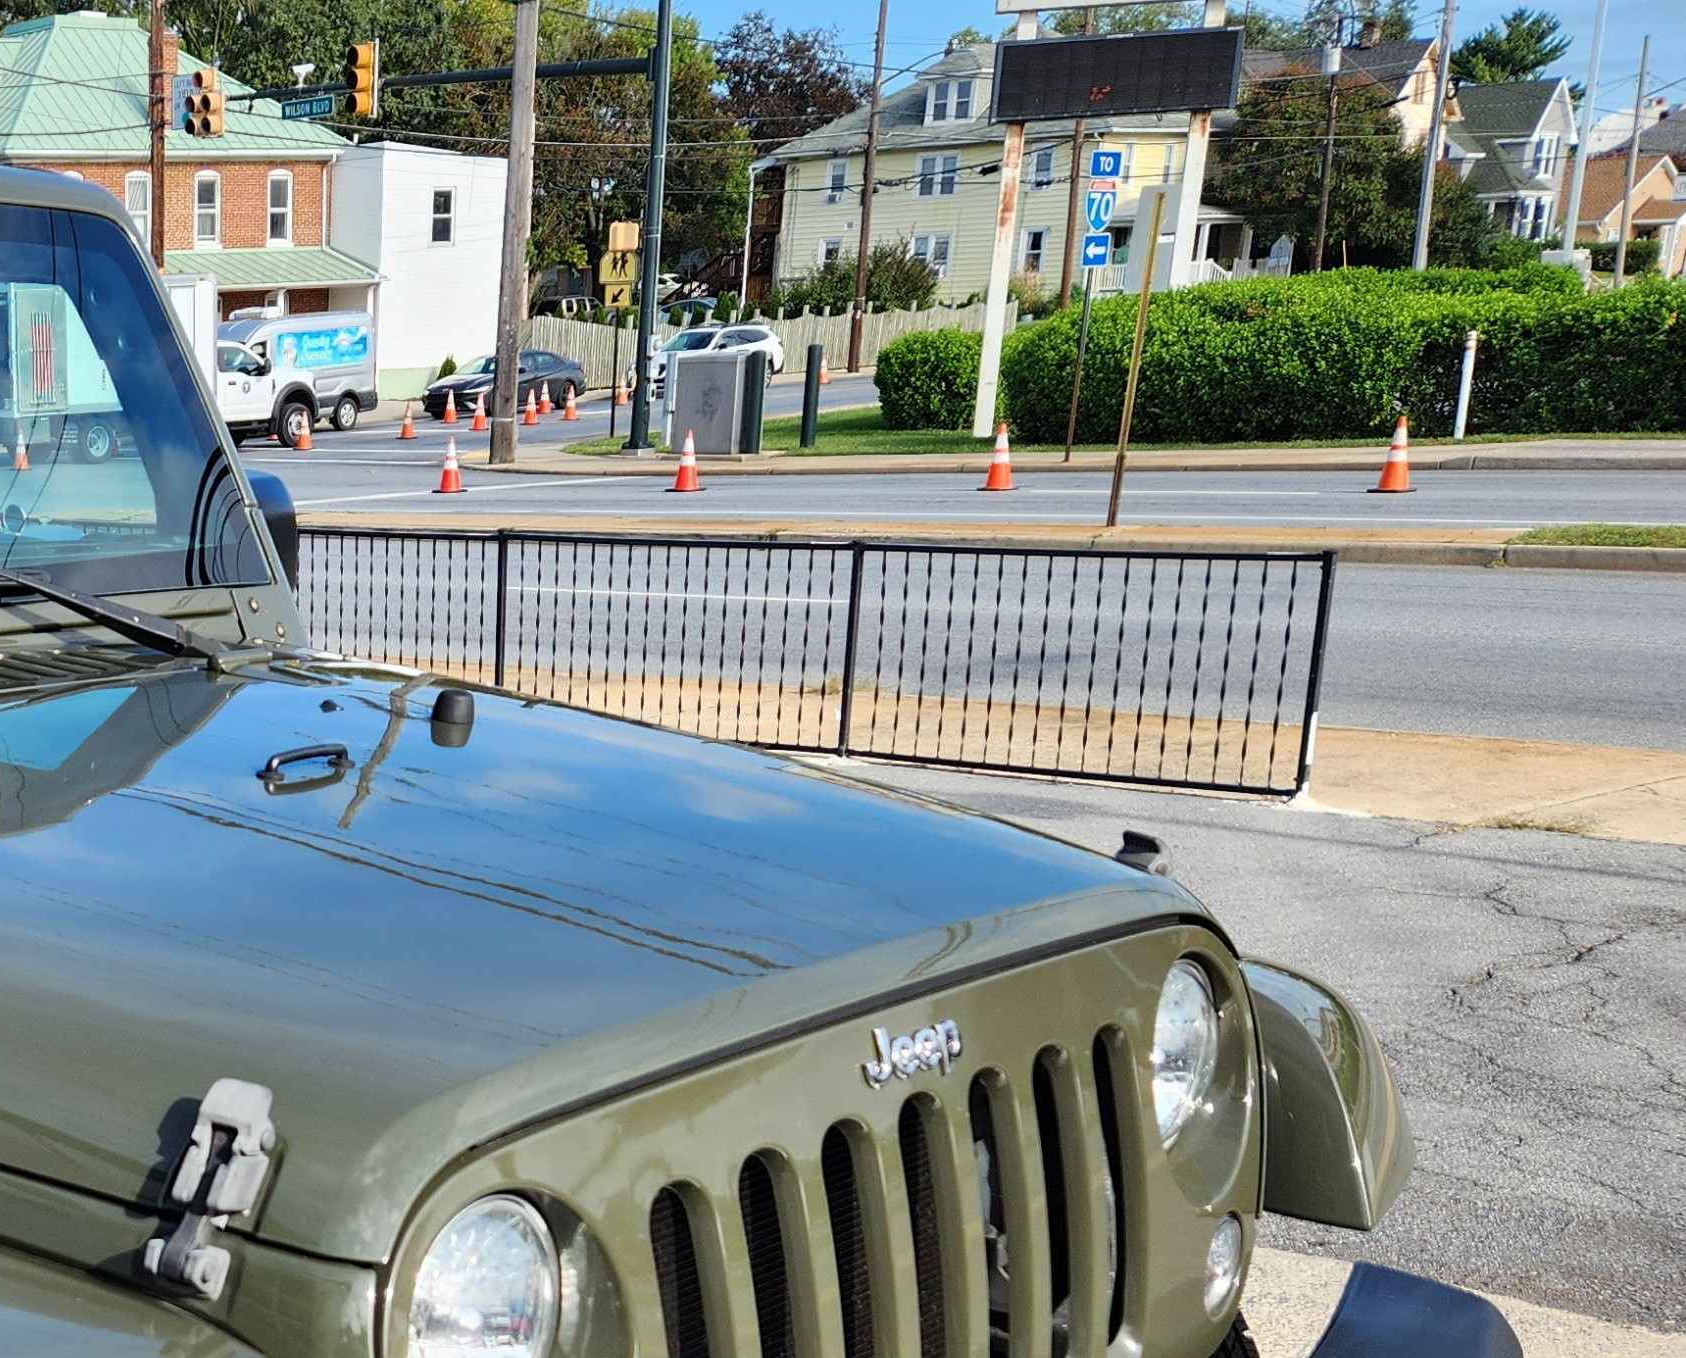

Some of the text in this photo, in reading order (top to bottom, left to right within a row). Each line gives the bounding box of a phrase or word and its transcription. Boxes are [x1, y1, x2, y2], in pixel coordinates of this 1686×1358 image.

[284, 100, 330, 117] WILSON BLVD
[1099, 155, 1114, 173] TO
[1089, 192, 1114, 222] 70
[863, 1019, 962, 1091] Jeep
